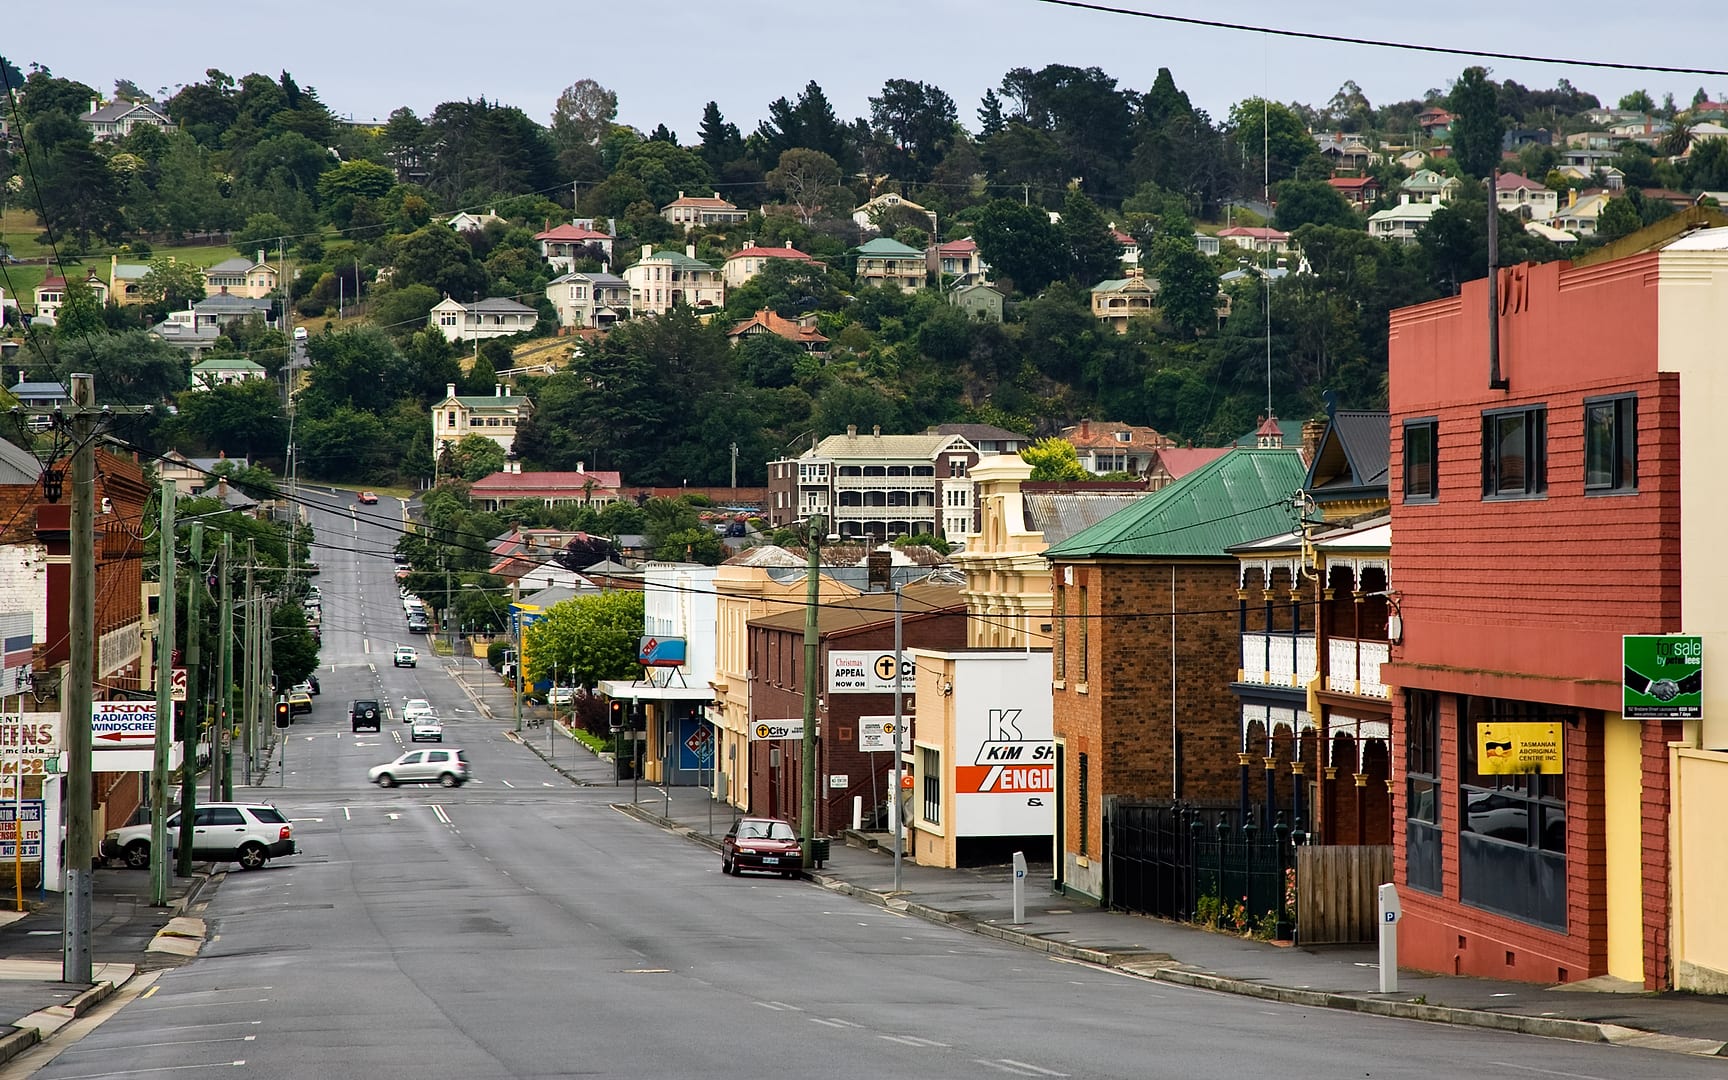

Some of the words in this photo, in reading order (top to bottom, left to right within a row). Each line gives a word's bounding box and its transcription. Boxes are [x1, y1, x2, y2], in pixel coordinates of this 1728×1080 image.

[835, 658, 862, 667] Christmas
[835, 669, 865, 677] APPEAL
[93, 713, 156, 721] RADIATORS
[769, 727, 789, 736] City
[1027, 797, 1044, 807] &
